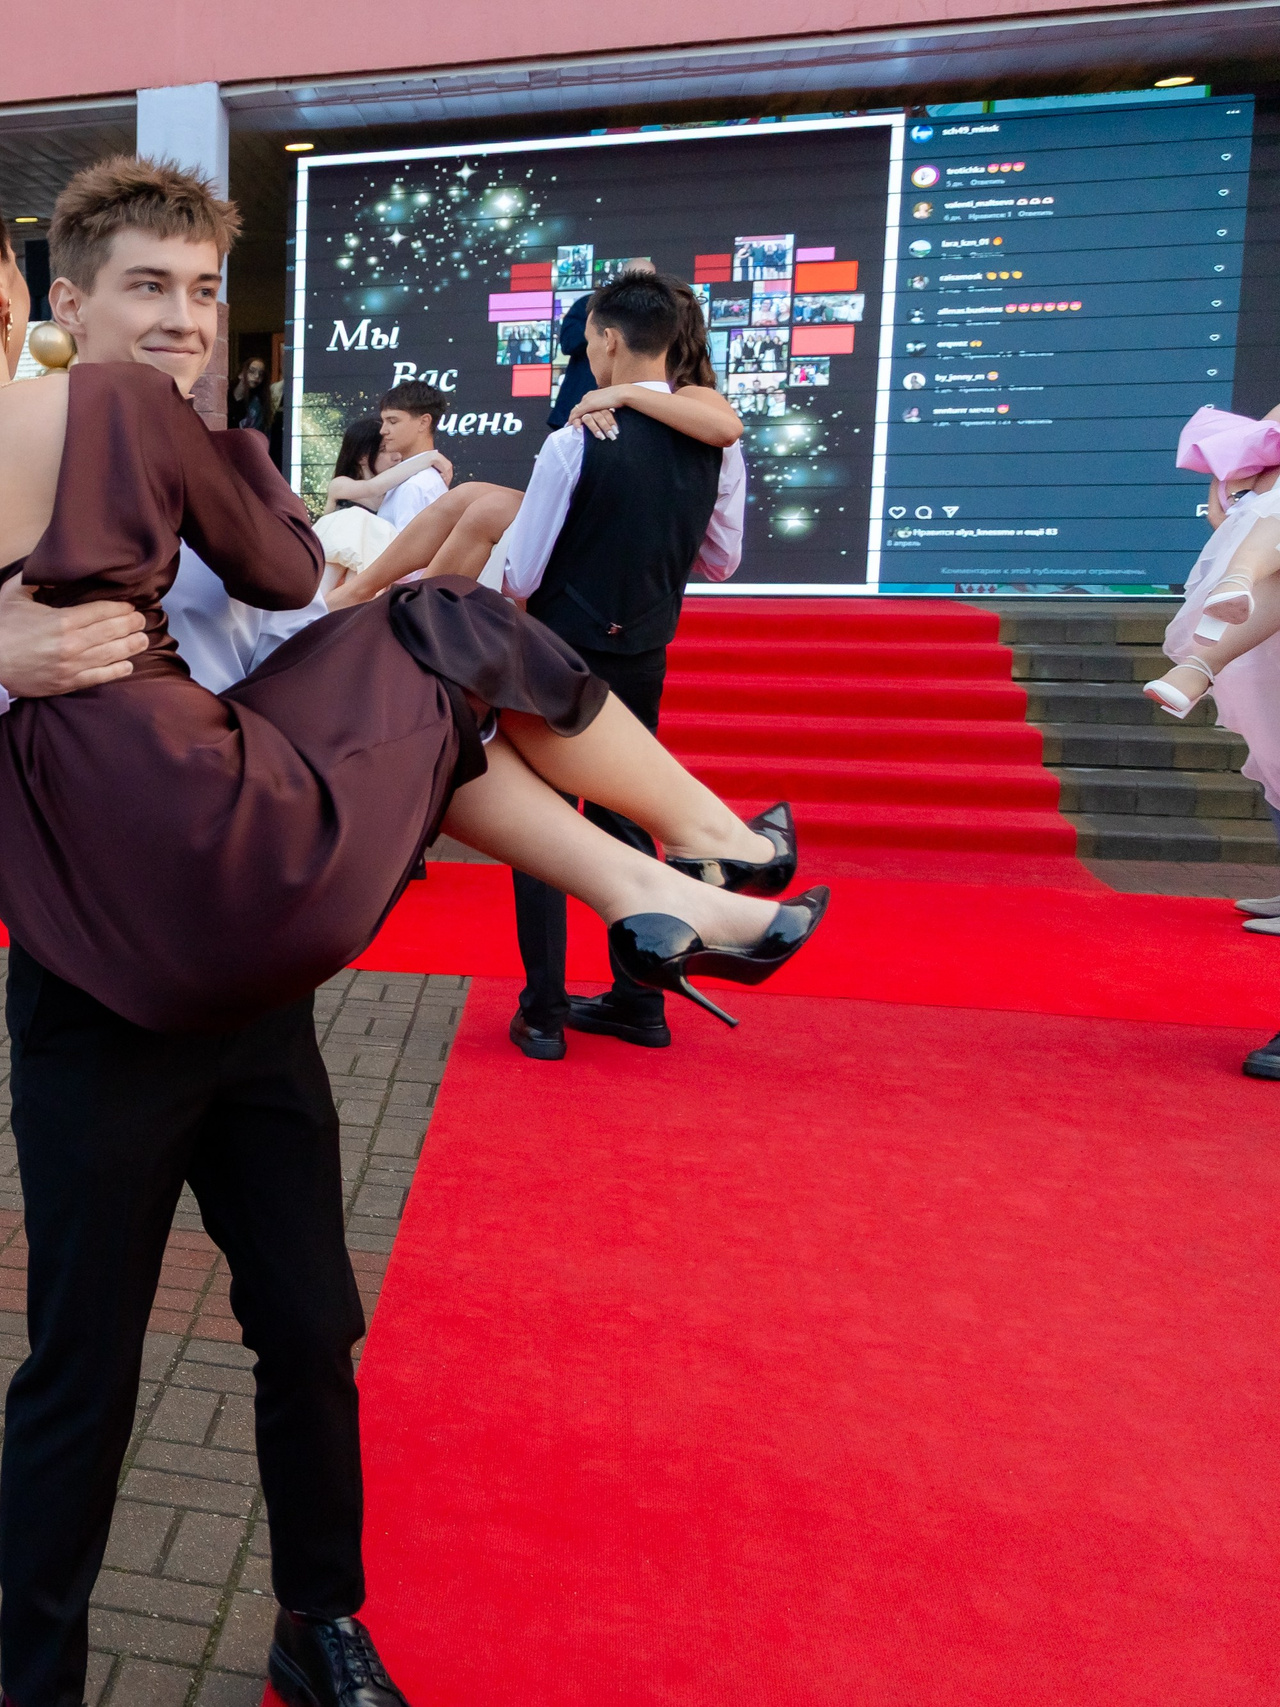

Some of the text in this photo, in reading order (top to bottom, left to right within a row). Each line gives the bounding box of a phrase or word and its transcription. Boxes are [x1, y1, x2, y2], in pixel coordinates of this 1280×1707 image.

[325, 318, 400, 352] Мы
[388, 361, 459, 392] Вас
[437, 412, 523, 437] чень
